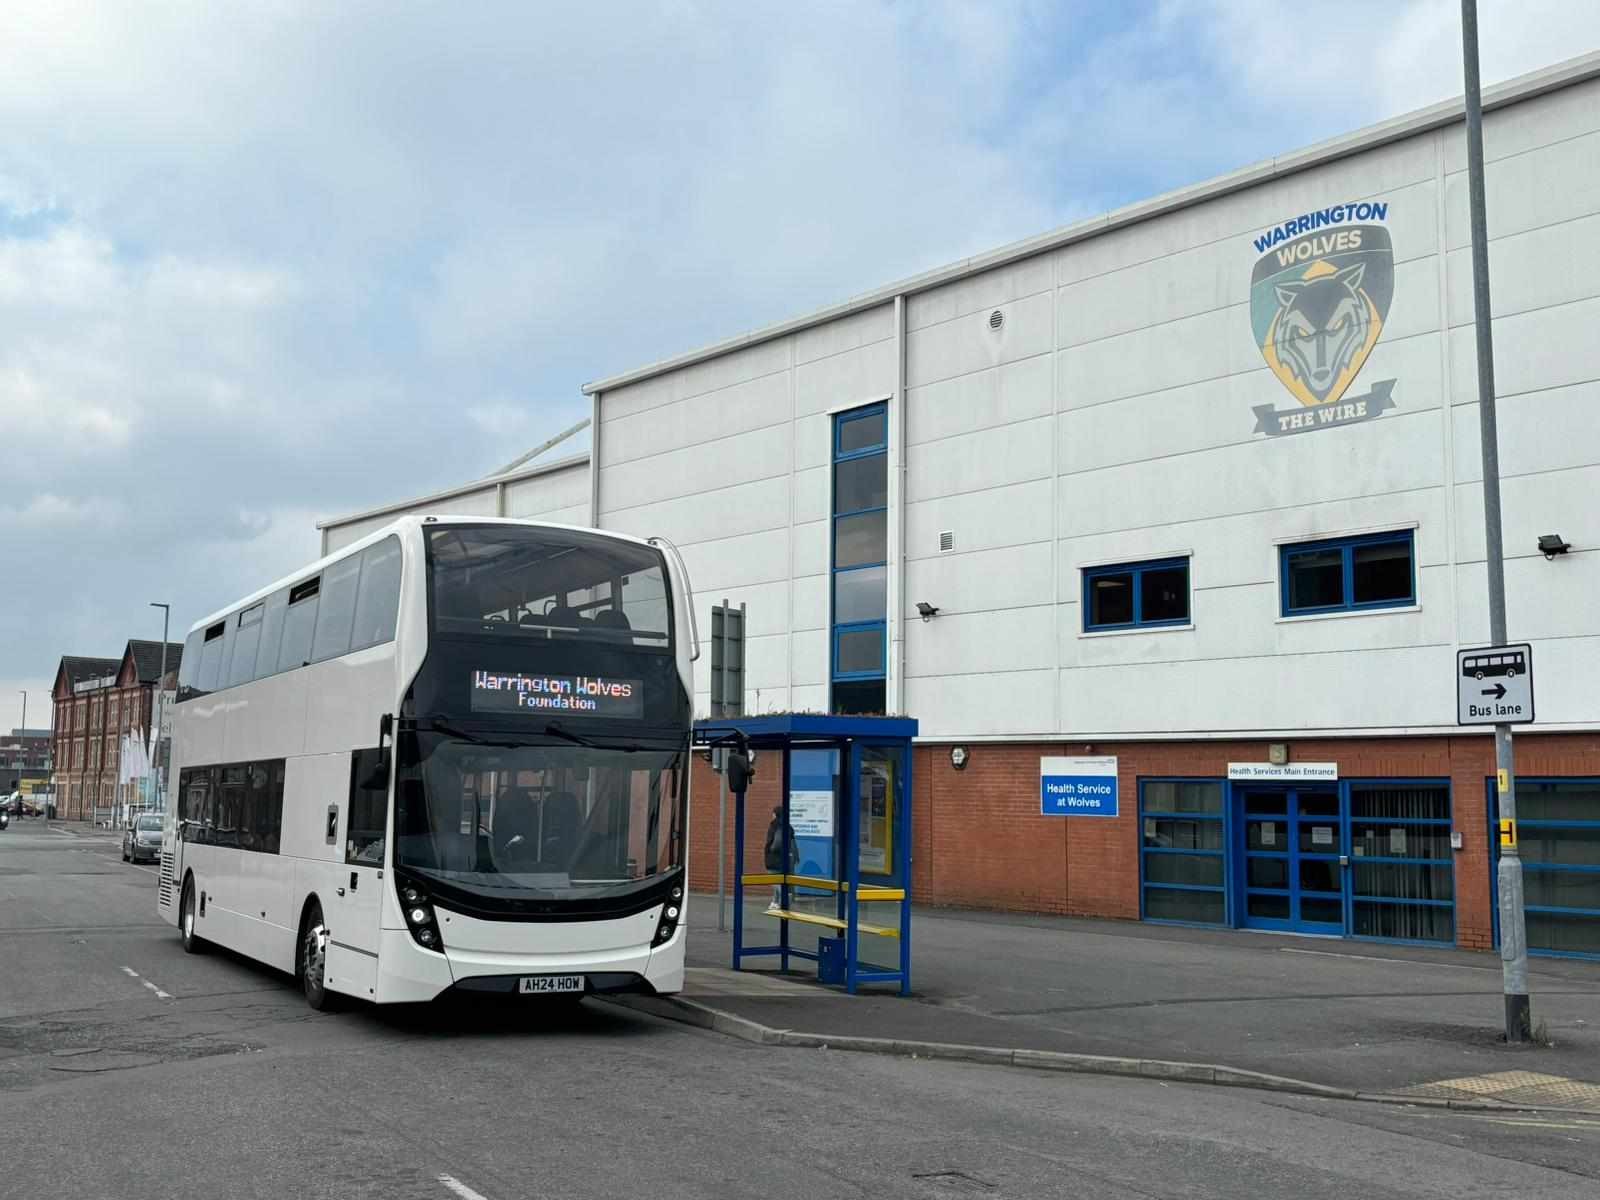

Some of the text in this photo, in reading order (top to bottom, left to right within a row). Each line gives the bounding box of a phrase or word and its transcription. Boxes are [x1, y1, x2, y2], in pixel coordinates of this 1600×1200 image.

[1253, 203, 1388, 253] WARRINGTON
[1277, 230, 1362, 267] WOLVES
[1279, 401, 1367, 431] THE WIRE
[475, 670, 632, 697] Warrington Wolves
[518, 692, 597, 710] Foundation
[1469, 703, 1522, 717] Bus lane
[1230, 767, 1335, 776] Health Services Main Entrance
[1047, 783, 1111, 794] Health Service
[1056, 796, 1101, 808] at Wolves
[525, 978, 555, 991] AH24
